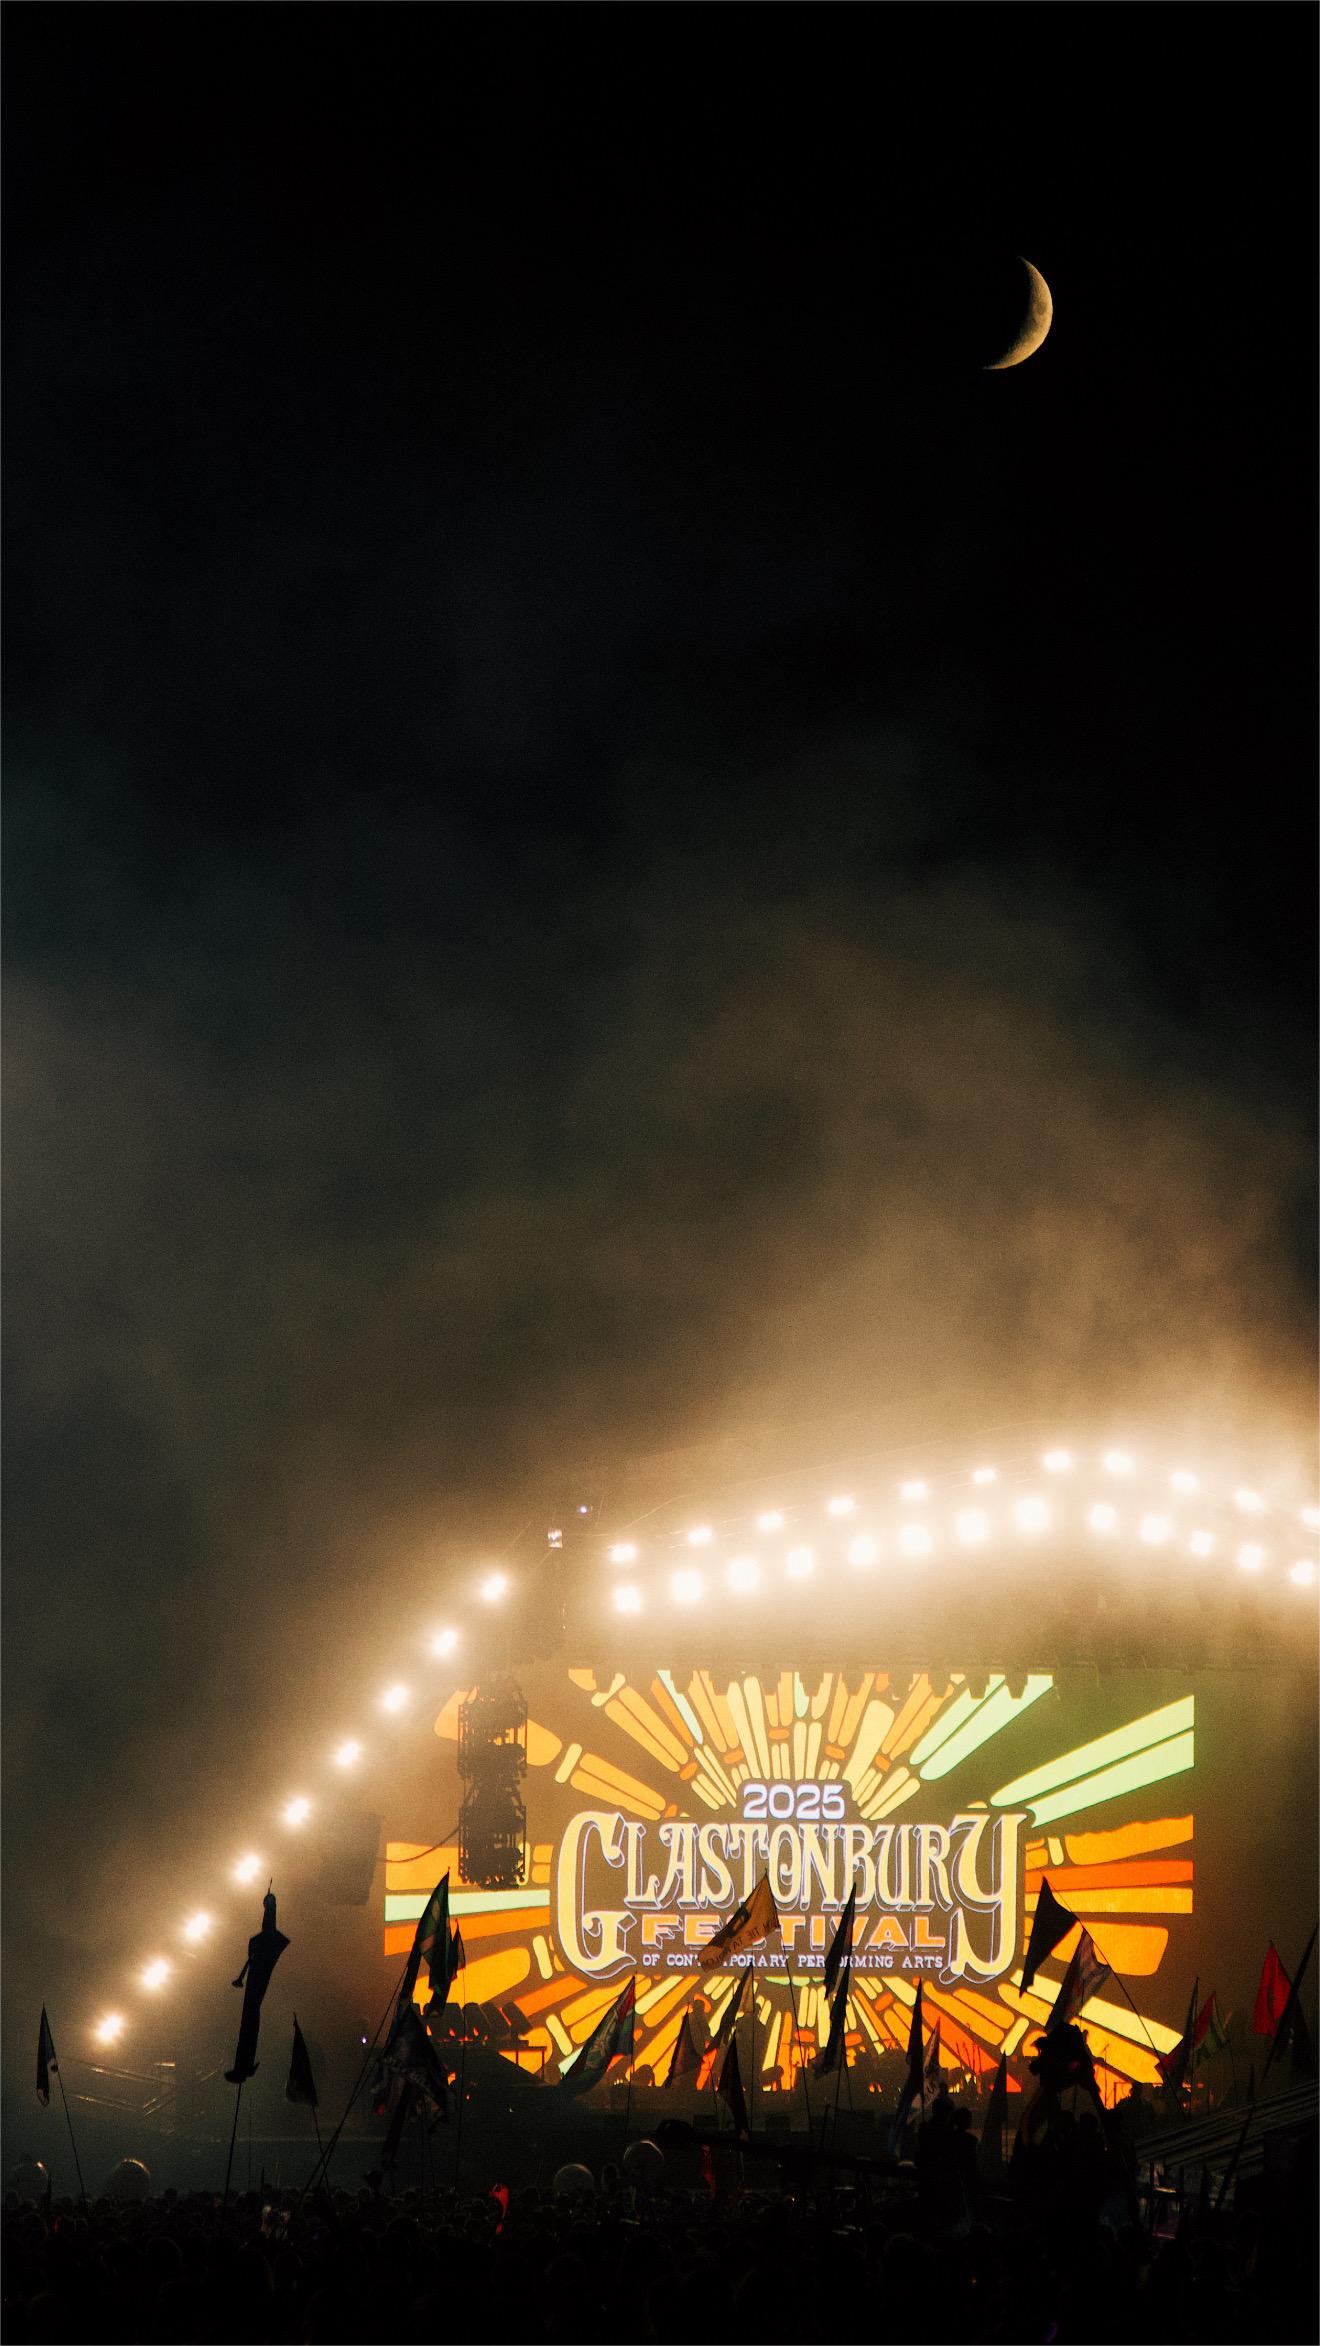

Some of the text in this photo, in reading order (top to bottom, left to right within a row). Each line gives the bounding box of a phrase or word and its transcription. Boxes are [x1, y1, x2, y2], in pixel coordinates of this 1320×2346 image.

[743, 1783, 846, 1819] 2025
[557, 1811, 1028, 1984] GLASTONBURY
[640, 1914, 947, 1950] FETIVAL
[642, 1953, 943, 1969] OF CONPORARY PERRMING ARTS
